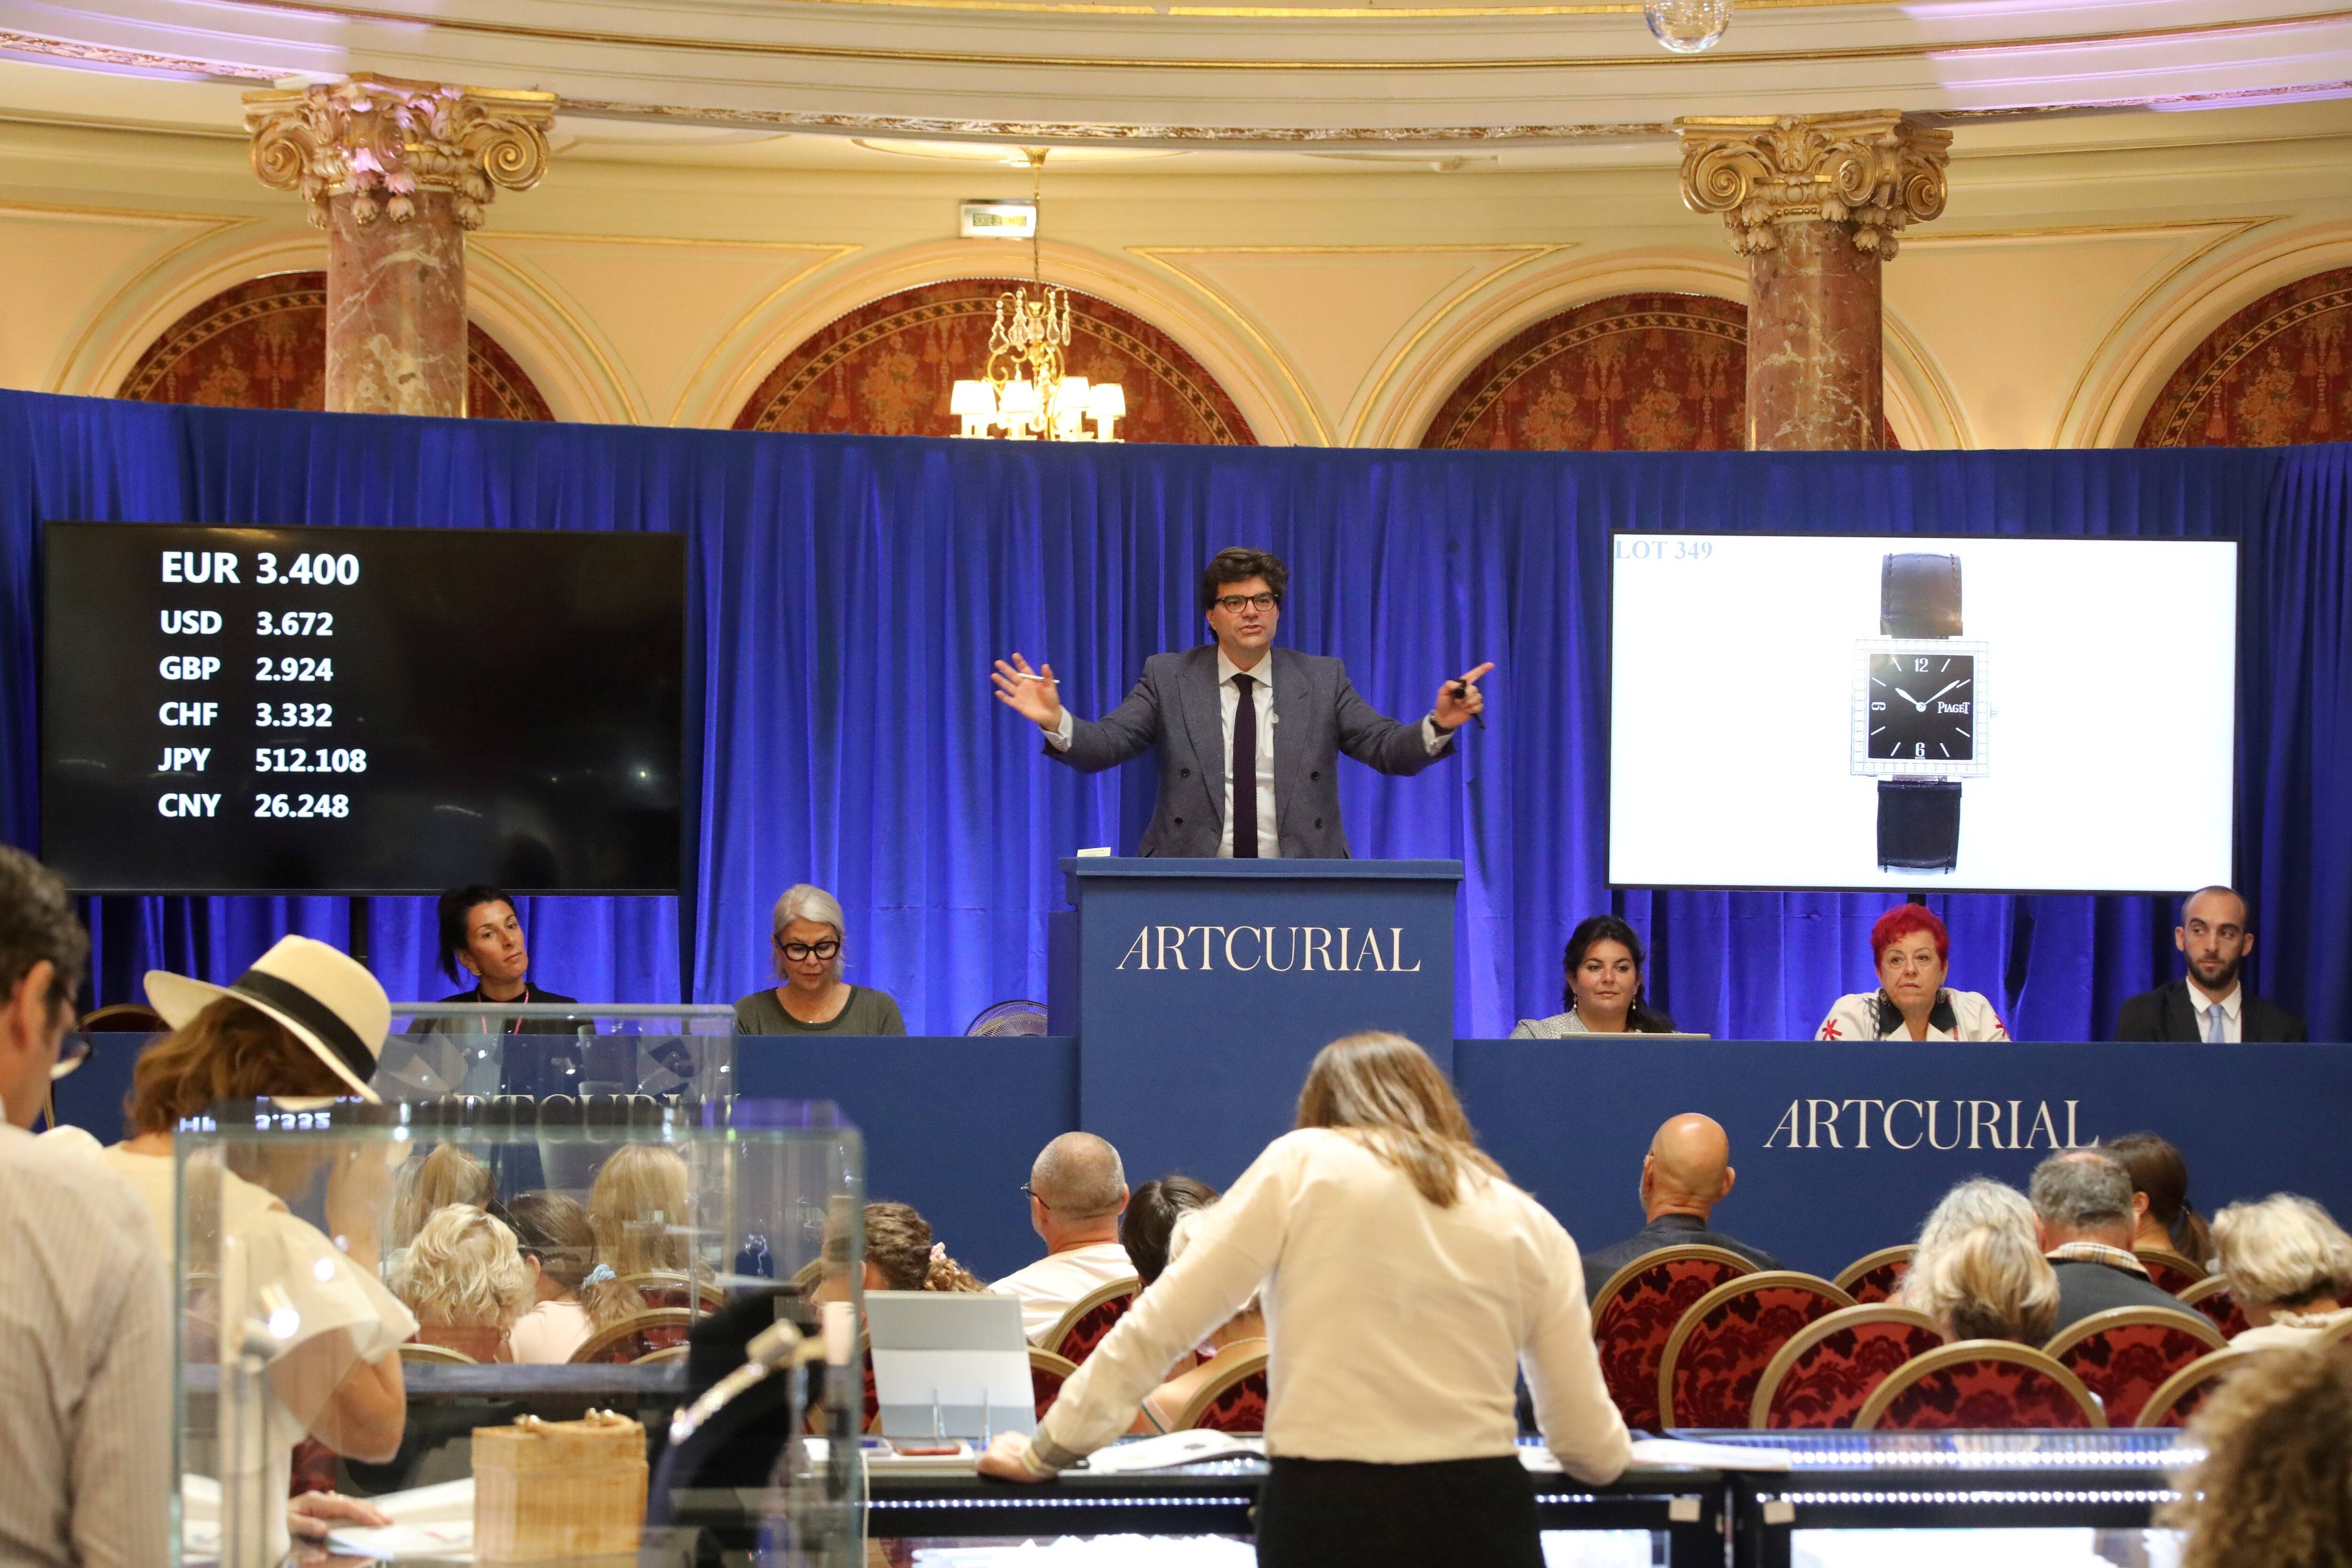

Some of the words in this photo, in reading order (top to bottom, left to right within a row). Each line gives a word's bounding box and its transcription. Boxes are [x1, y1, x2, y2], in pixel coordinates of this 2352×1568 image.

[1616, 541, 1668, 559] LOT
[1675, 541, 1712, 559] 349
[162, 551, 240, 583] EUR
[256, 552, 359, 585] 3.400
[160, 610, 222, 634] USD
[256, 611, 333, 636] 3.672
[159, 656, 221, 680] GBP
[255, 657, 334, 682] 2.924
[1914, 658, 1929, 672] 12
[159, 701, 218, 726] CHF
[255, 702, 333, 727] 3.332
[1937, 701, 1971, 714] PIAGET
[158, 748, 211, 772] JPY
[255, 748, 367, 772] 512.108
[1915, 742, 1925, 756] 6
[158, 793, 222, 817] CNY
[254, 794, 349, 818] 26.248
[1115, 926, 1421, 971] ARTCURIAL
[1763, 1099, 2098, 1149] ARTCURIAL
